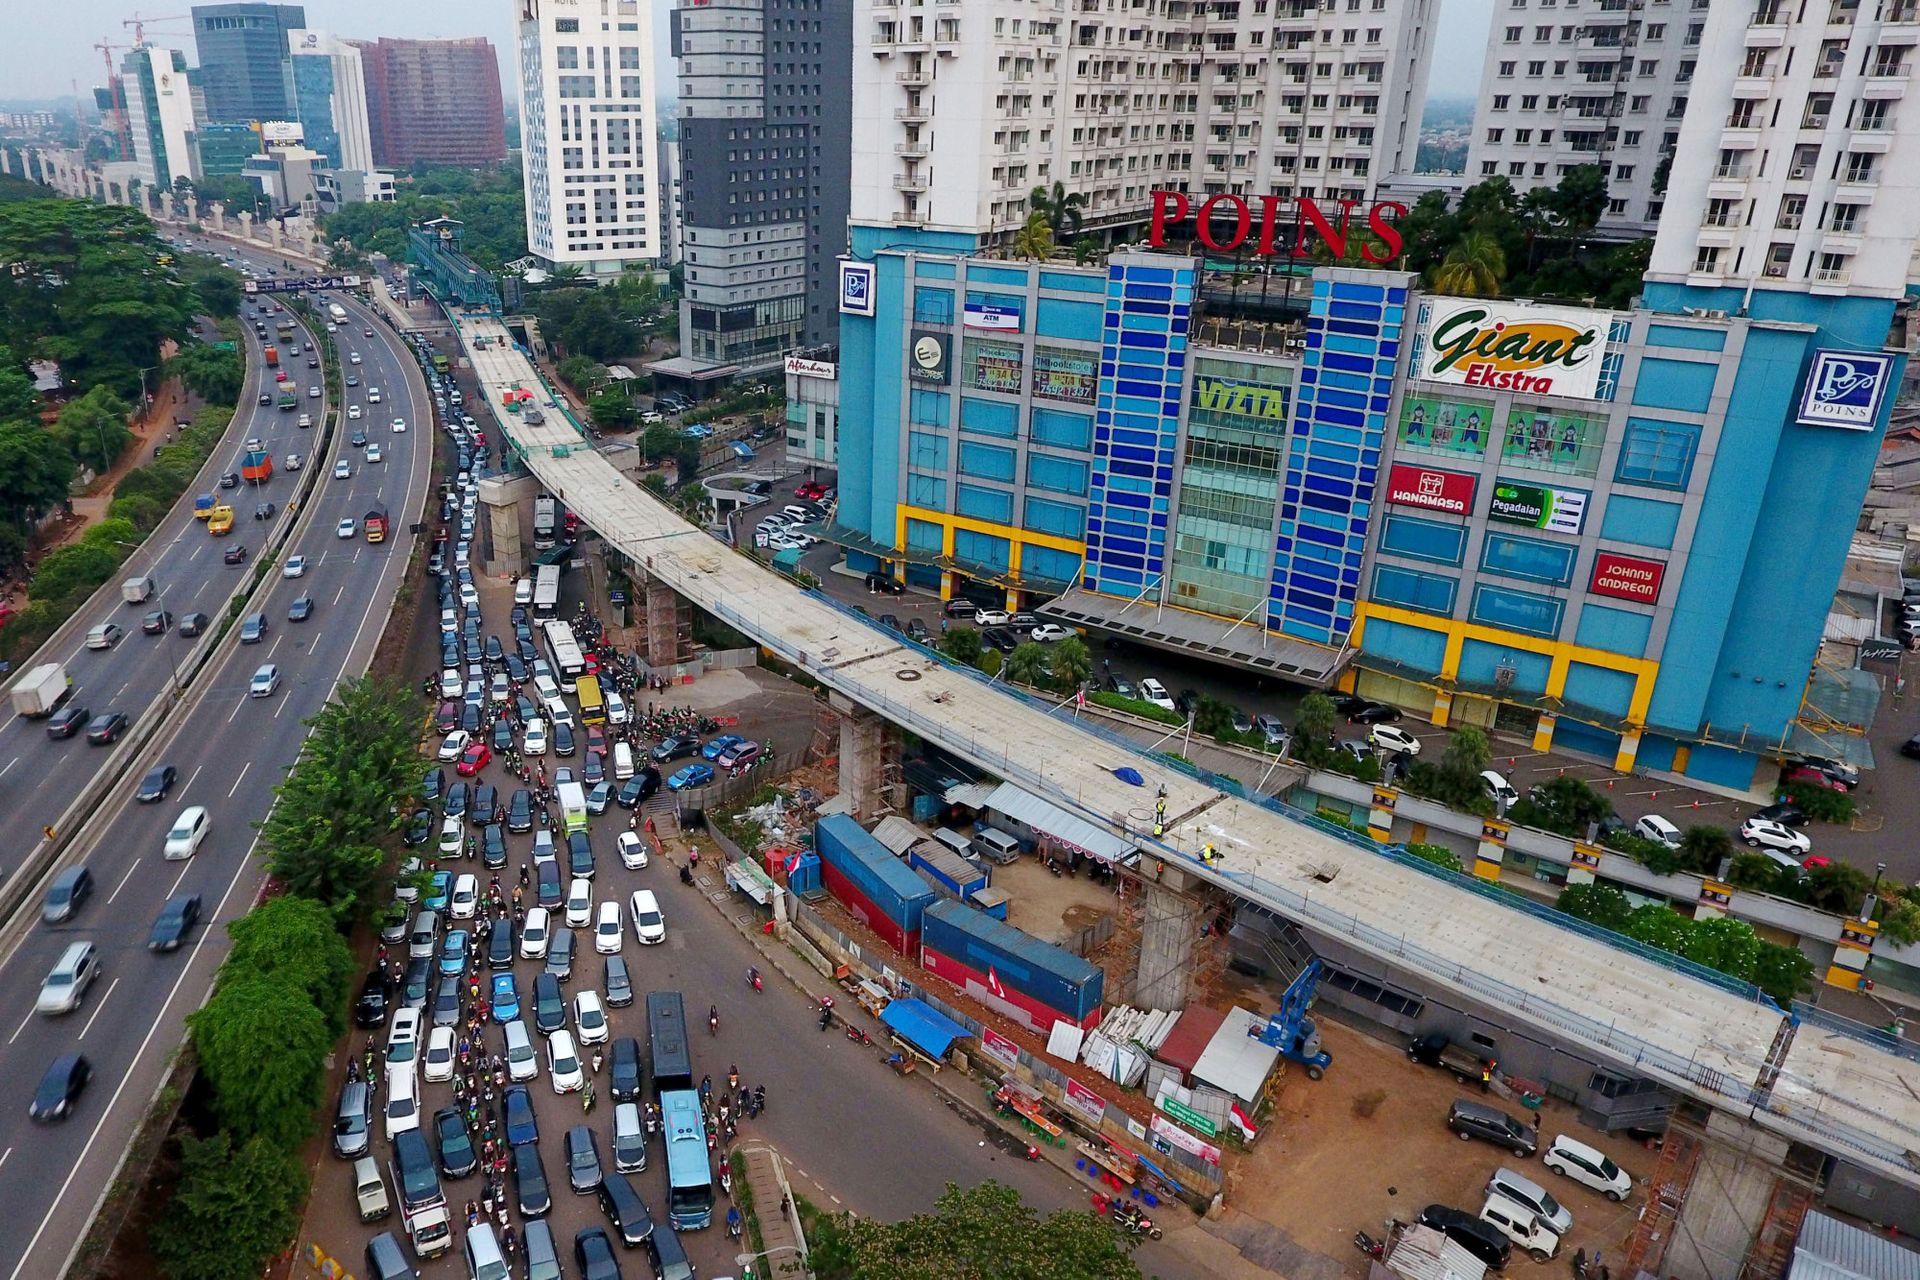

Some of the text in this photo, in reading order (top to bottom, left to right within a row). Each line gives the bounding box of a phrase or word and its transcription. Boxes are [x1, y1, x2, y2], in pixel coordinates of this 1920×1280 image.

[1148, 191, 1407, 263] POINS
[983, 314, 999, 322] ATM
[1432, 309, 1596, 374] Giant
[1463, 363, 1553, 394] Ekstra
[1198, 380, 1283, 418] VIZTA
[1811, 403, 1867, 417] POINS
[1393, 490, 1464, 511] HANAMASA
[1492, 499, 1541, 516] Pegadaian
